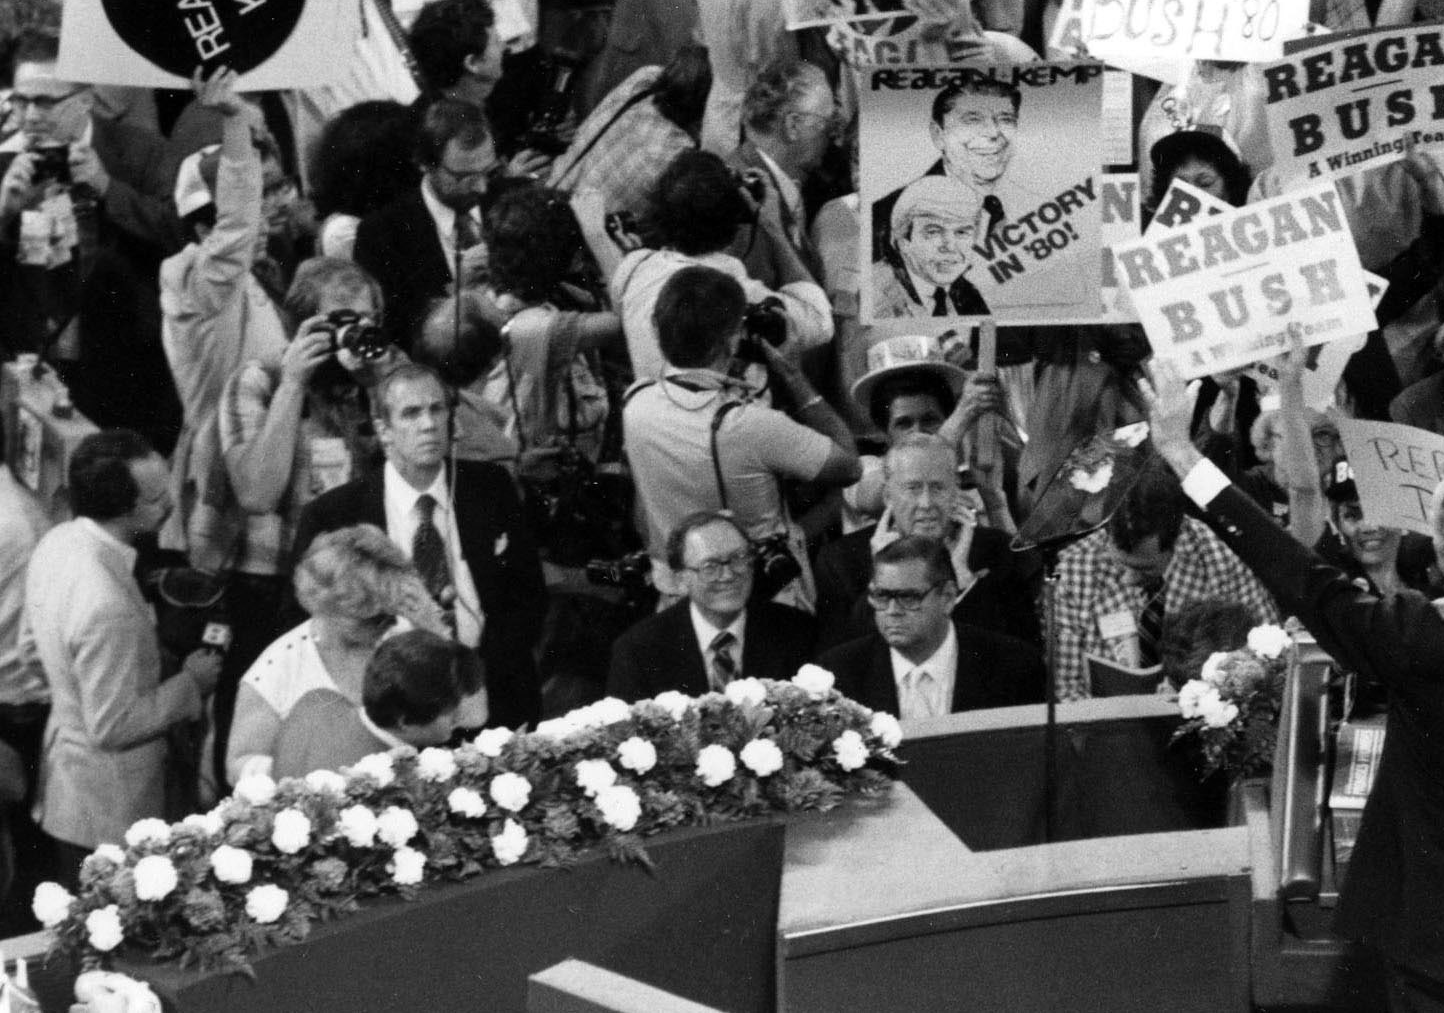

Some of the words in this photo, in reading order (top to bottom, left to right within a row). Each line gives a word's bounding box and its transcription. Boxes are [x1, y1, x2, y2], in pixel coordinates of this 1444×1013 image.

[1012, 64, 1102, 88] KEMP
[1309, 160, 1322, 178] A
[1327, 138, 1406, 171] Winning
[972, 176, 1098, 262] VICTORY
[1119, 190, 1343, 290] REAGAN
[987, 252, 1025, 284] IN
[1161, 258, 1346, 344] BUSH
